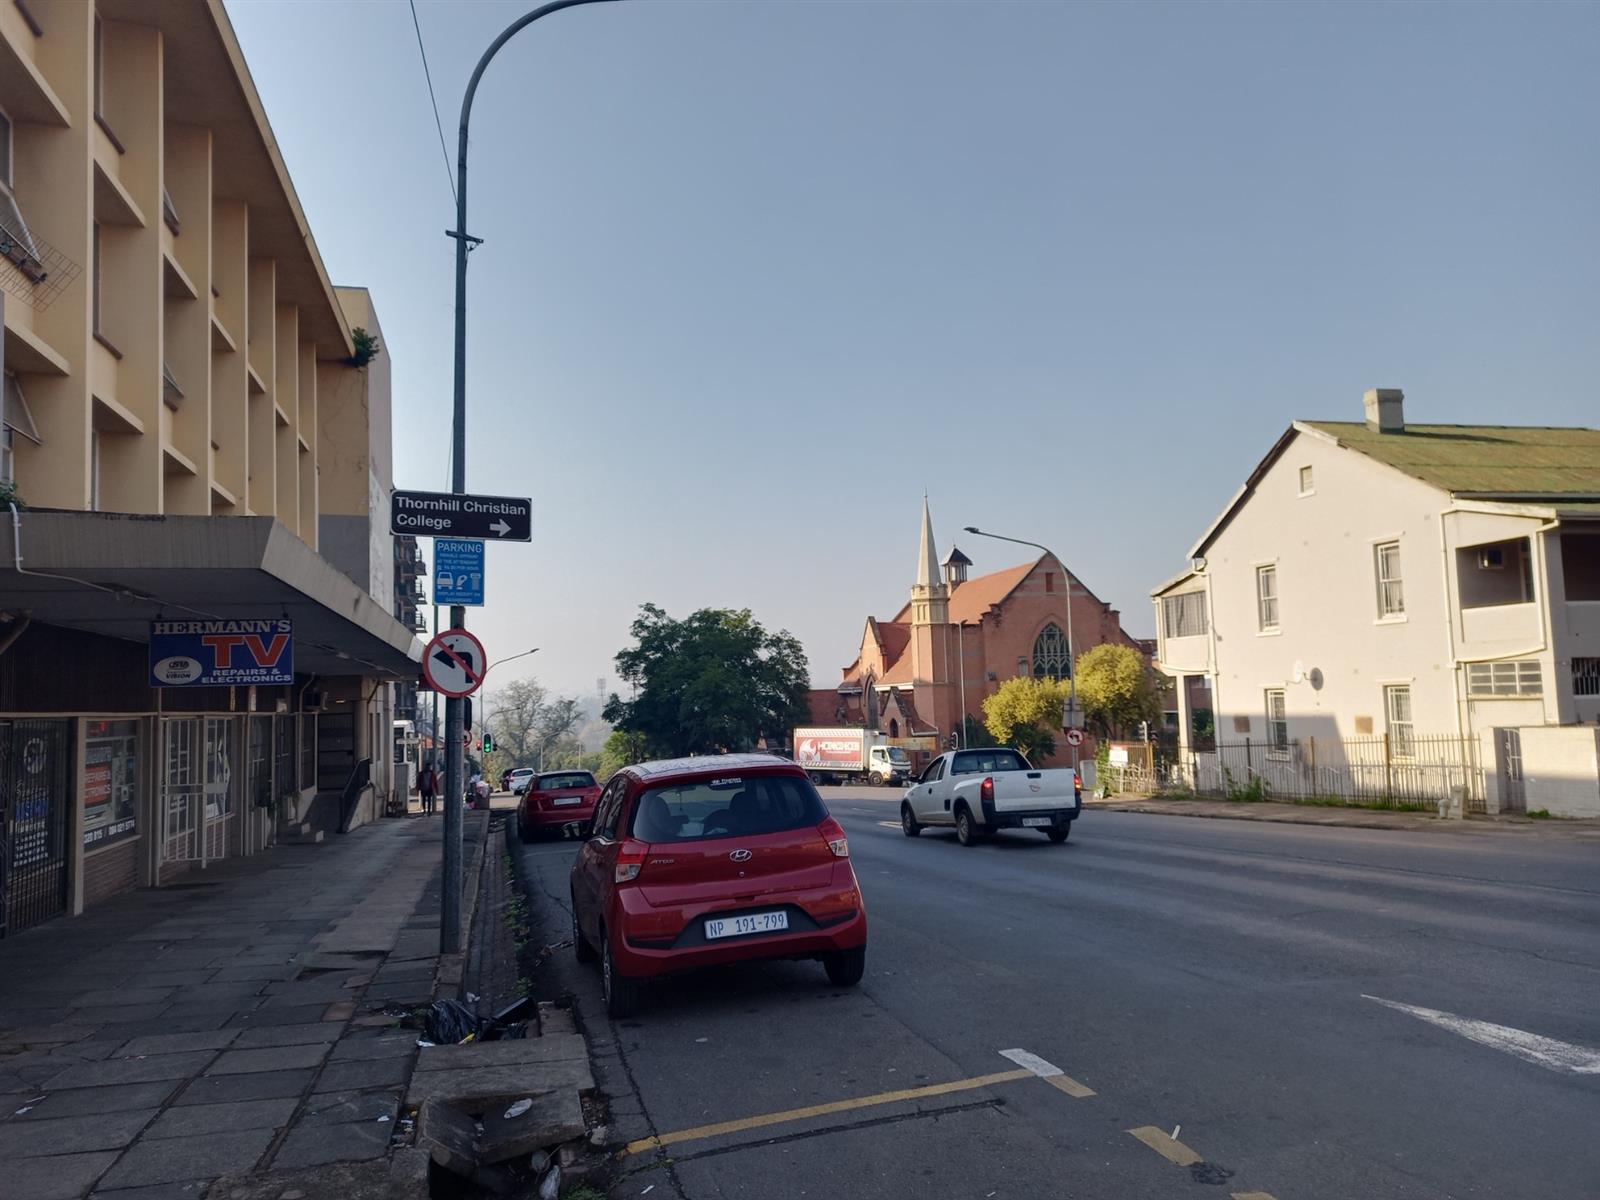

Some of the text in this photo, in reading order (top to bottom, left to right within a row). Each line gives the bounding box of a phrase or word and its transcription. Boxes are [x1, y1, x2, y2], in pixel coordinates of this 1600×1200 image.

[395, 496, 526, 515] Thornhill Christian
[396, 513, 452, 530] College
[437, 542, 482, 553] PARKING
[153, 620, 292, 635] HERMANN'S
[201, 633, 291, 669] TV
[201, 675, 291, 684] ELECTRONICS
[212, 669, 267, 677] REPAIRS
[709, 913, 785, 937] NP 191-799
